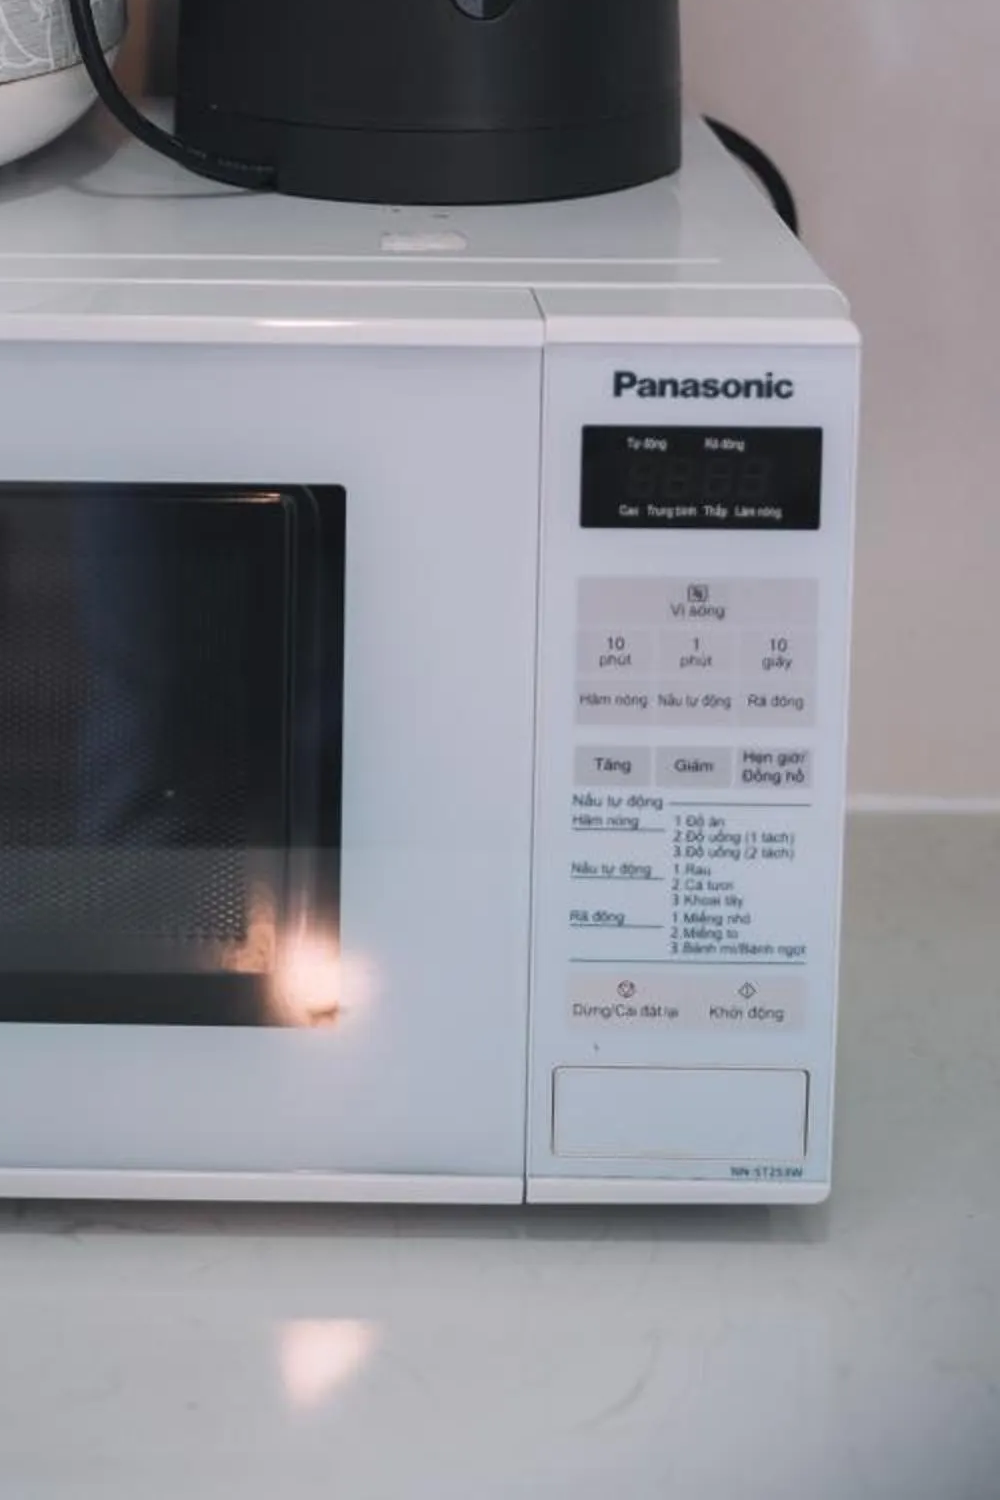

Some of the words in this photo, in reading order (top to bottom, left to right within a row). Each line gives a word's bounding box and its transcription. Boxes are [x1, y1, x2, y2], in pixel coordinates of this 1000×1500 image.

[613, 370, 794, 399] Panasonic
[670, 603, 685, 617] Vi
[689, 603, 725, 621] sóng
[607, 636, 625, 651] 10
[770, 638, 788, 652] 10
[599, 653, 632, 668] phút
[679, 654, 713, 670] phút
[761, 655, 793, 671] giây
[615, 693, 649, 709] nóng
[594, 757, 632, 775] Tăng
[742, 750, 773, 766] Hẹn
[741, 768, 782, 786] Đồng
[785, 769, 804, 783] hồ
[572, 792, 602, 807] Nấu
[626, 794, 664, 811] động
[606, 815, 640, 830] nóng
[747, 1005, 785, 1022] động
